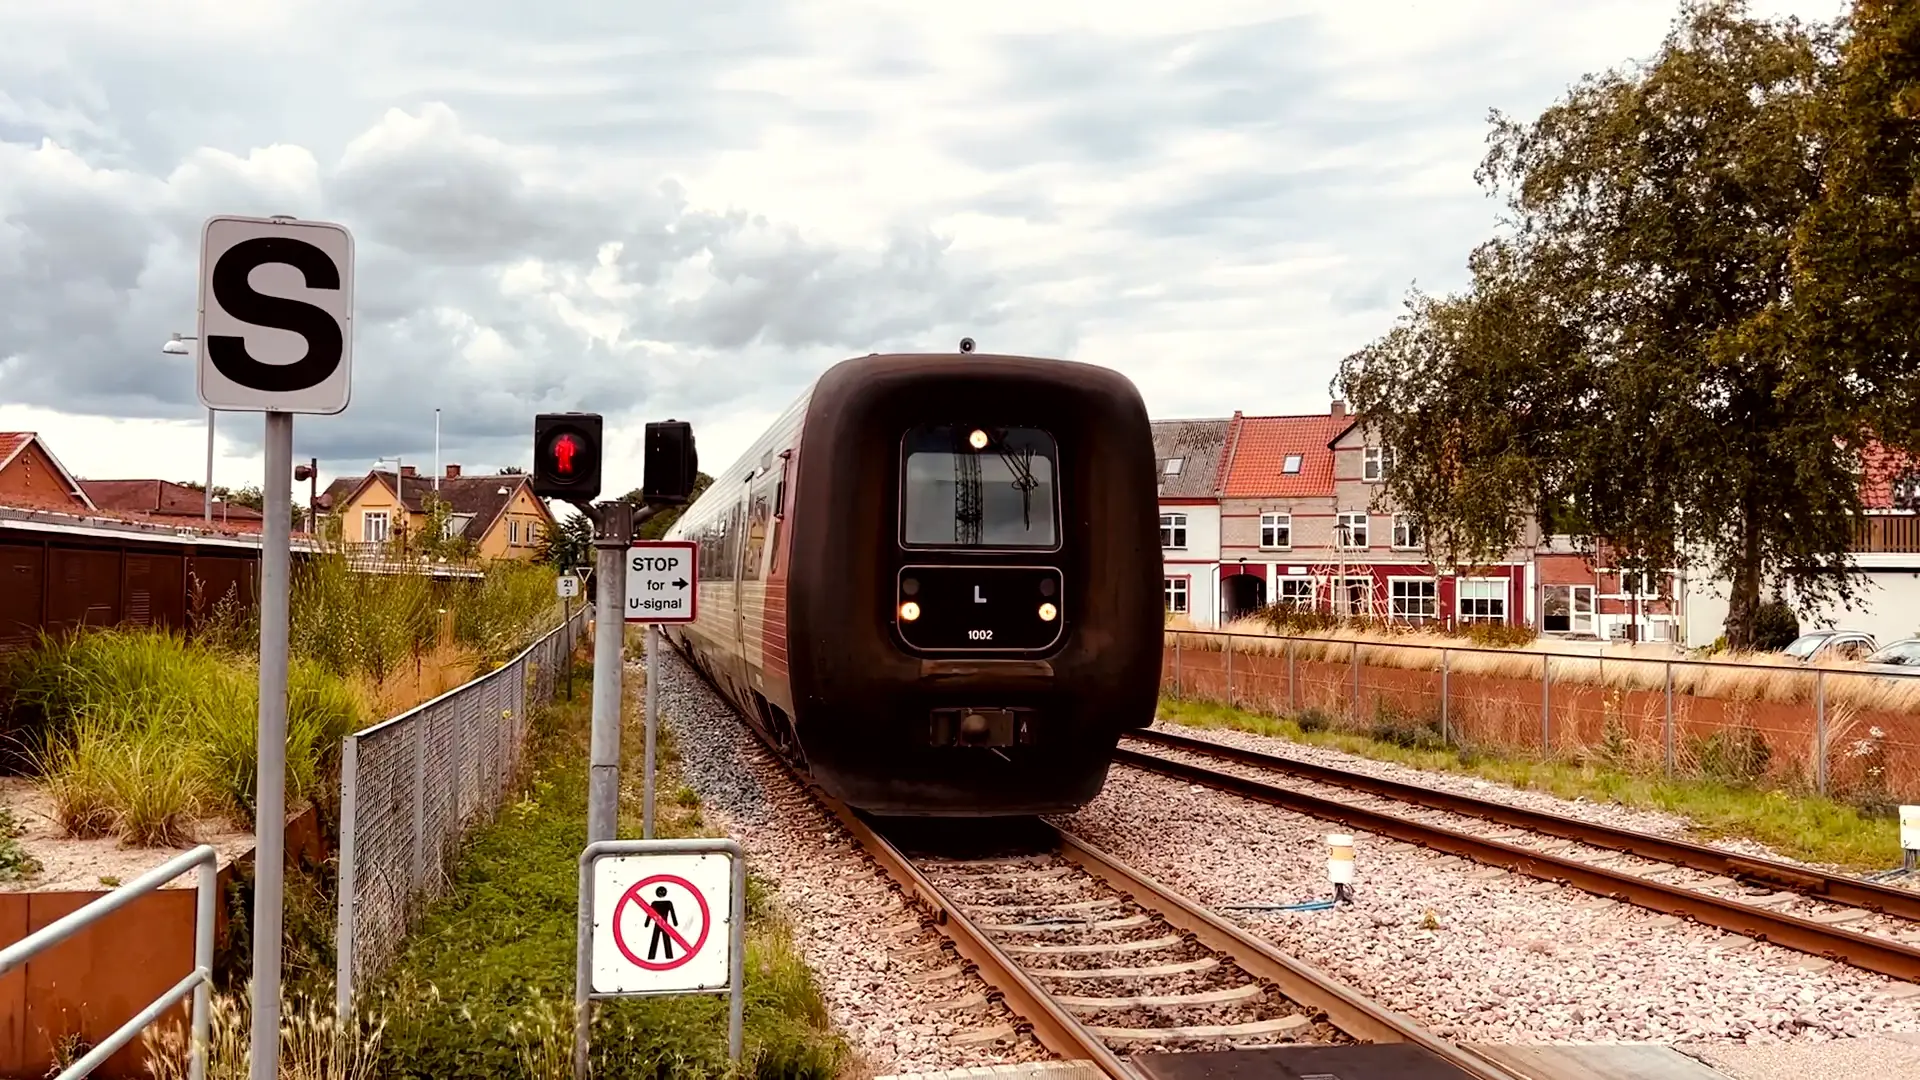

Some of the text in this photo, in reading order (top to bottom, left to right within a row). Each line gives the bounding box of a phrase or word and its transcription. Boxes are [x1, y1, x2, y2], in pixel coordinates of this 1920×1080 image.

[208, 237, 343, 392] S
[632, 557, 679, 571] STOP
[563, 579, 573, 587] 21
[647, 579, 665, 591] for
[974, 585, 987, 603] L
[629, 598, 682, 611] U-signal
[967, 630, 993, 640] 1002
